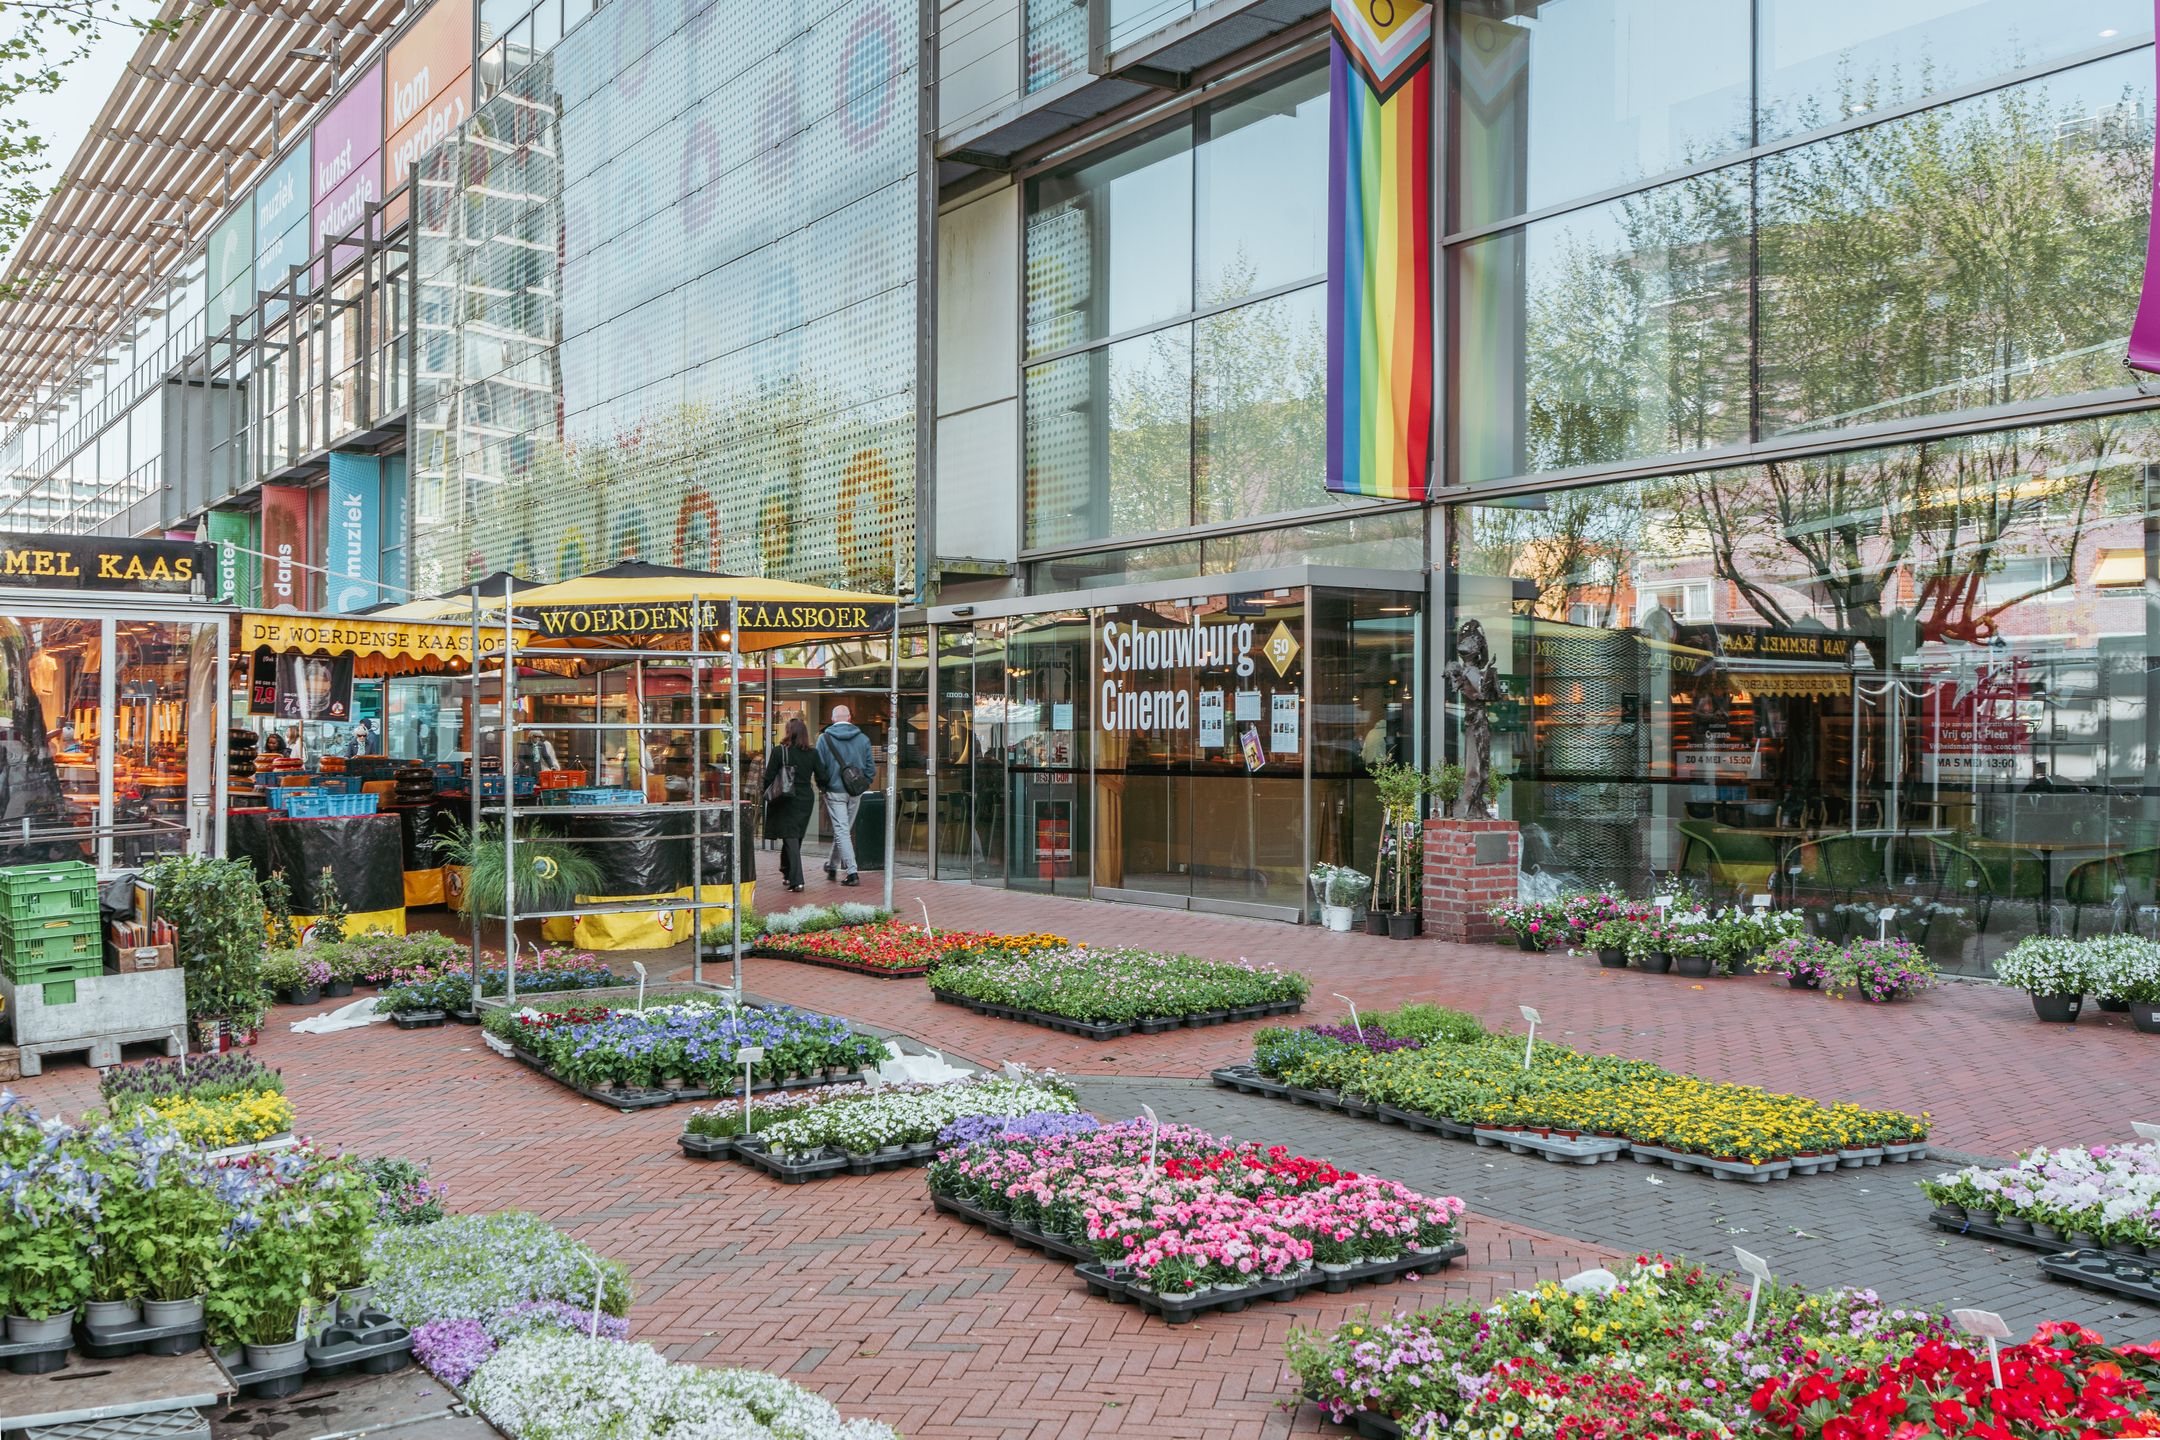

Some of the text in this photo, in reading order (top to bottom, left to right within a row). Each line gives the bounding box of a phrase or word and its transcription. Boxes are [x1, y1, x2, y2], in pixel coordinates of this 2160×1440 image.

[393, 65, 430, 128] kom
[319, 138, 352, 197] kunst
[393, 102, 453, 182] verder
[260, 171, 294, 230] muziek
[319, 174, 373, 248] educatie
[343, 493, 363, 578] muziek
[0, 550, 193, 582] MEL KAAS
[274, 543, 292, 597] dans
[253, 624, 280, 640] DE
[289, 627, 410, 649] WOERDENSE
[540, 605, 870, 635] WOERDENSE KAASBOER
[1102, 614, 1255, 677] Schouwburg
[1273, 638, 1289, 655] 50
[1101, 679, 1190, 731] Cinema
[1705, 730, 1731, 741] Cyrano
[1706, 756, 1721, 764] MEI
[1728, 756, 1752, 764] 15:00
[1942, 730, 1958, 741] Vrij
[1961, 731, 1972, 741] op
